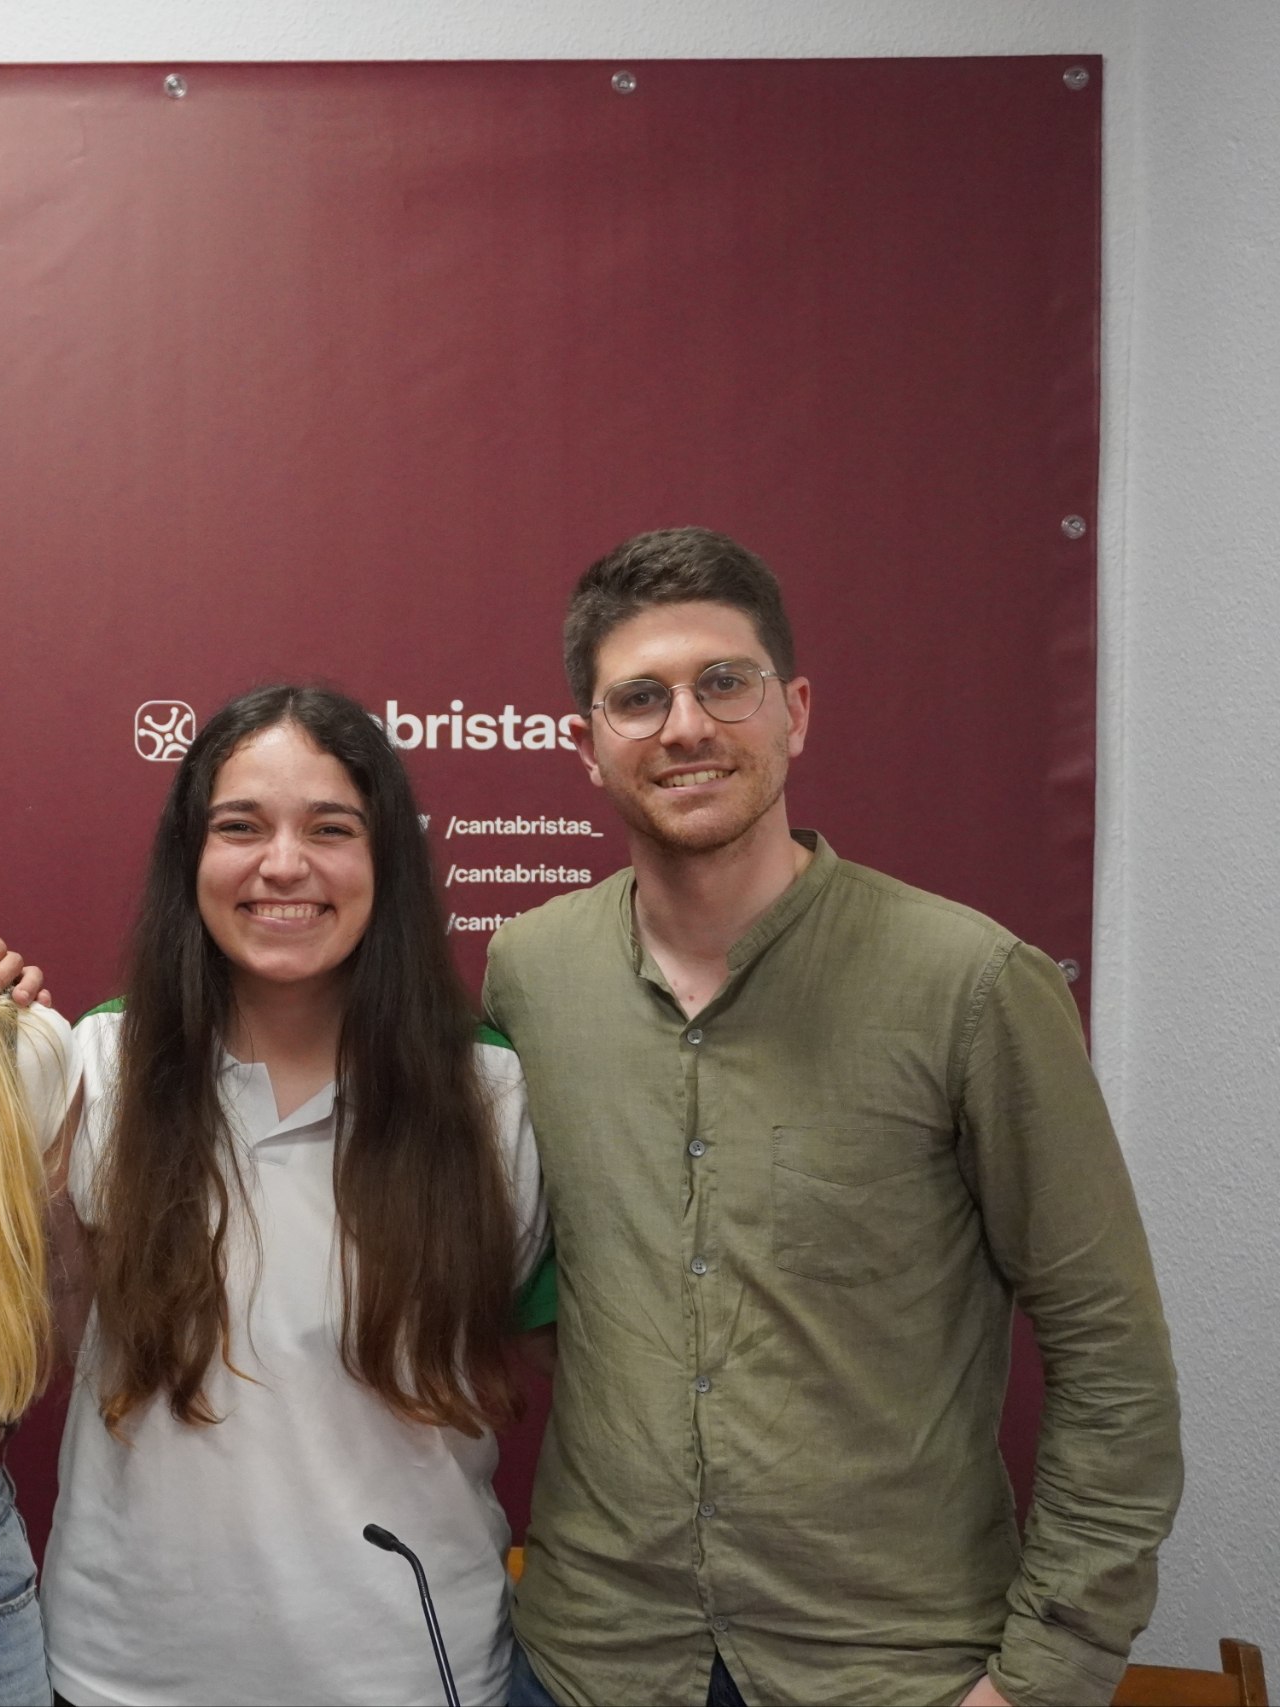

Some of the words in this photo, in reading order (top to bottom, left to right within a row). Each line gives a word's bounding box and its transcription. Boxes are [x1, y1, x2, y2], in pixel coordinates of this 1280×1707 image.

[368, 699, 580, 751] bristas
[445, 815, 605, 840] /cantabristas_
[445, 863, 592, 888] /cantabristas
[445, 912, 522, 936] /cant
